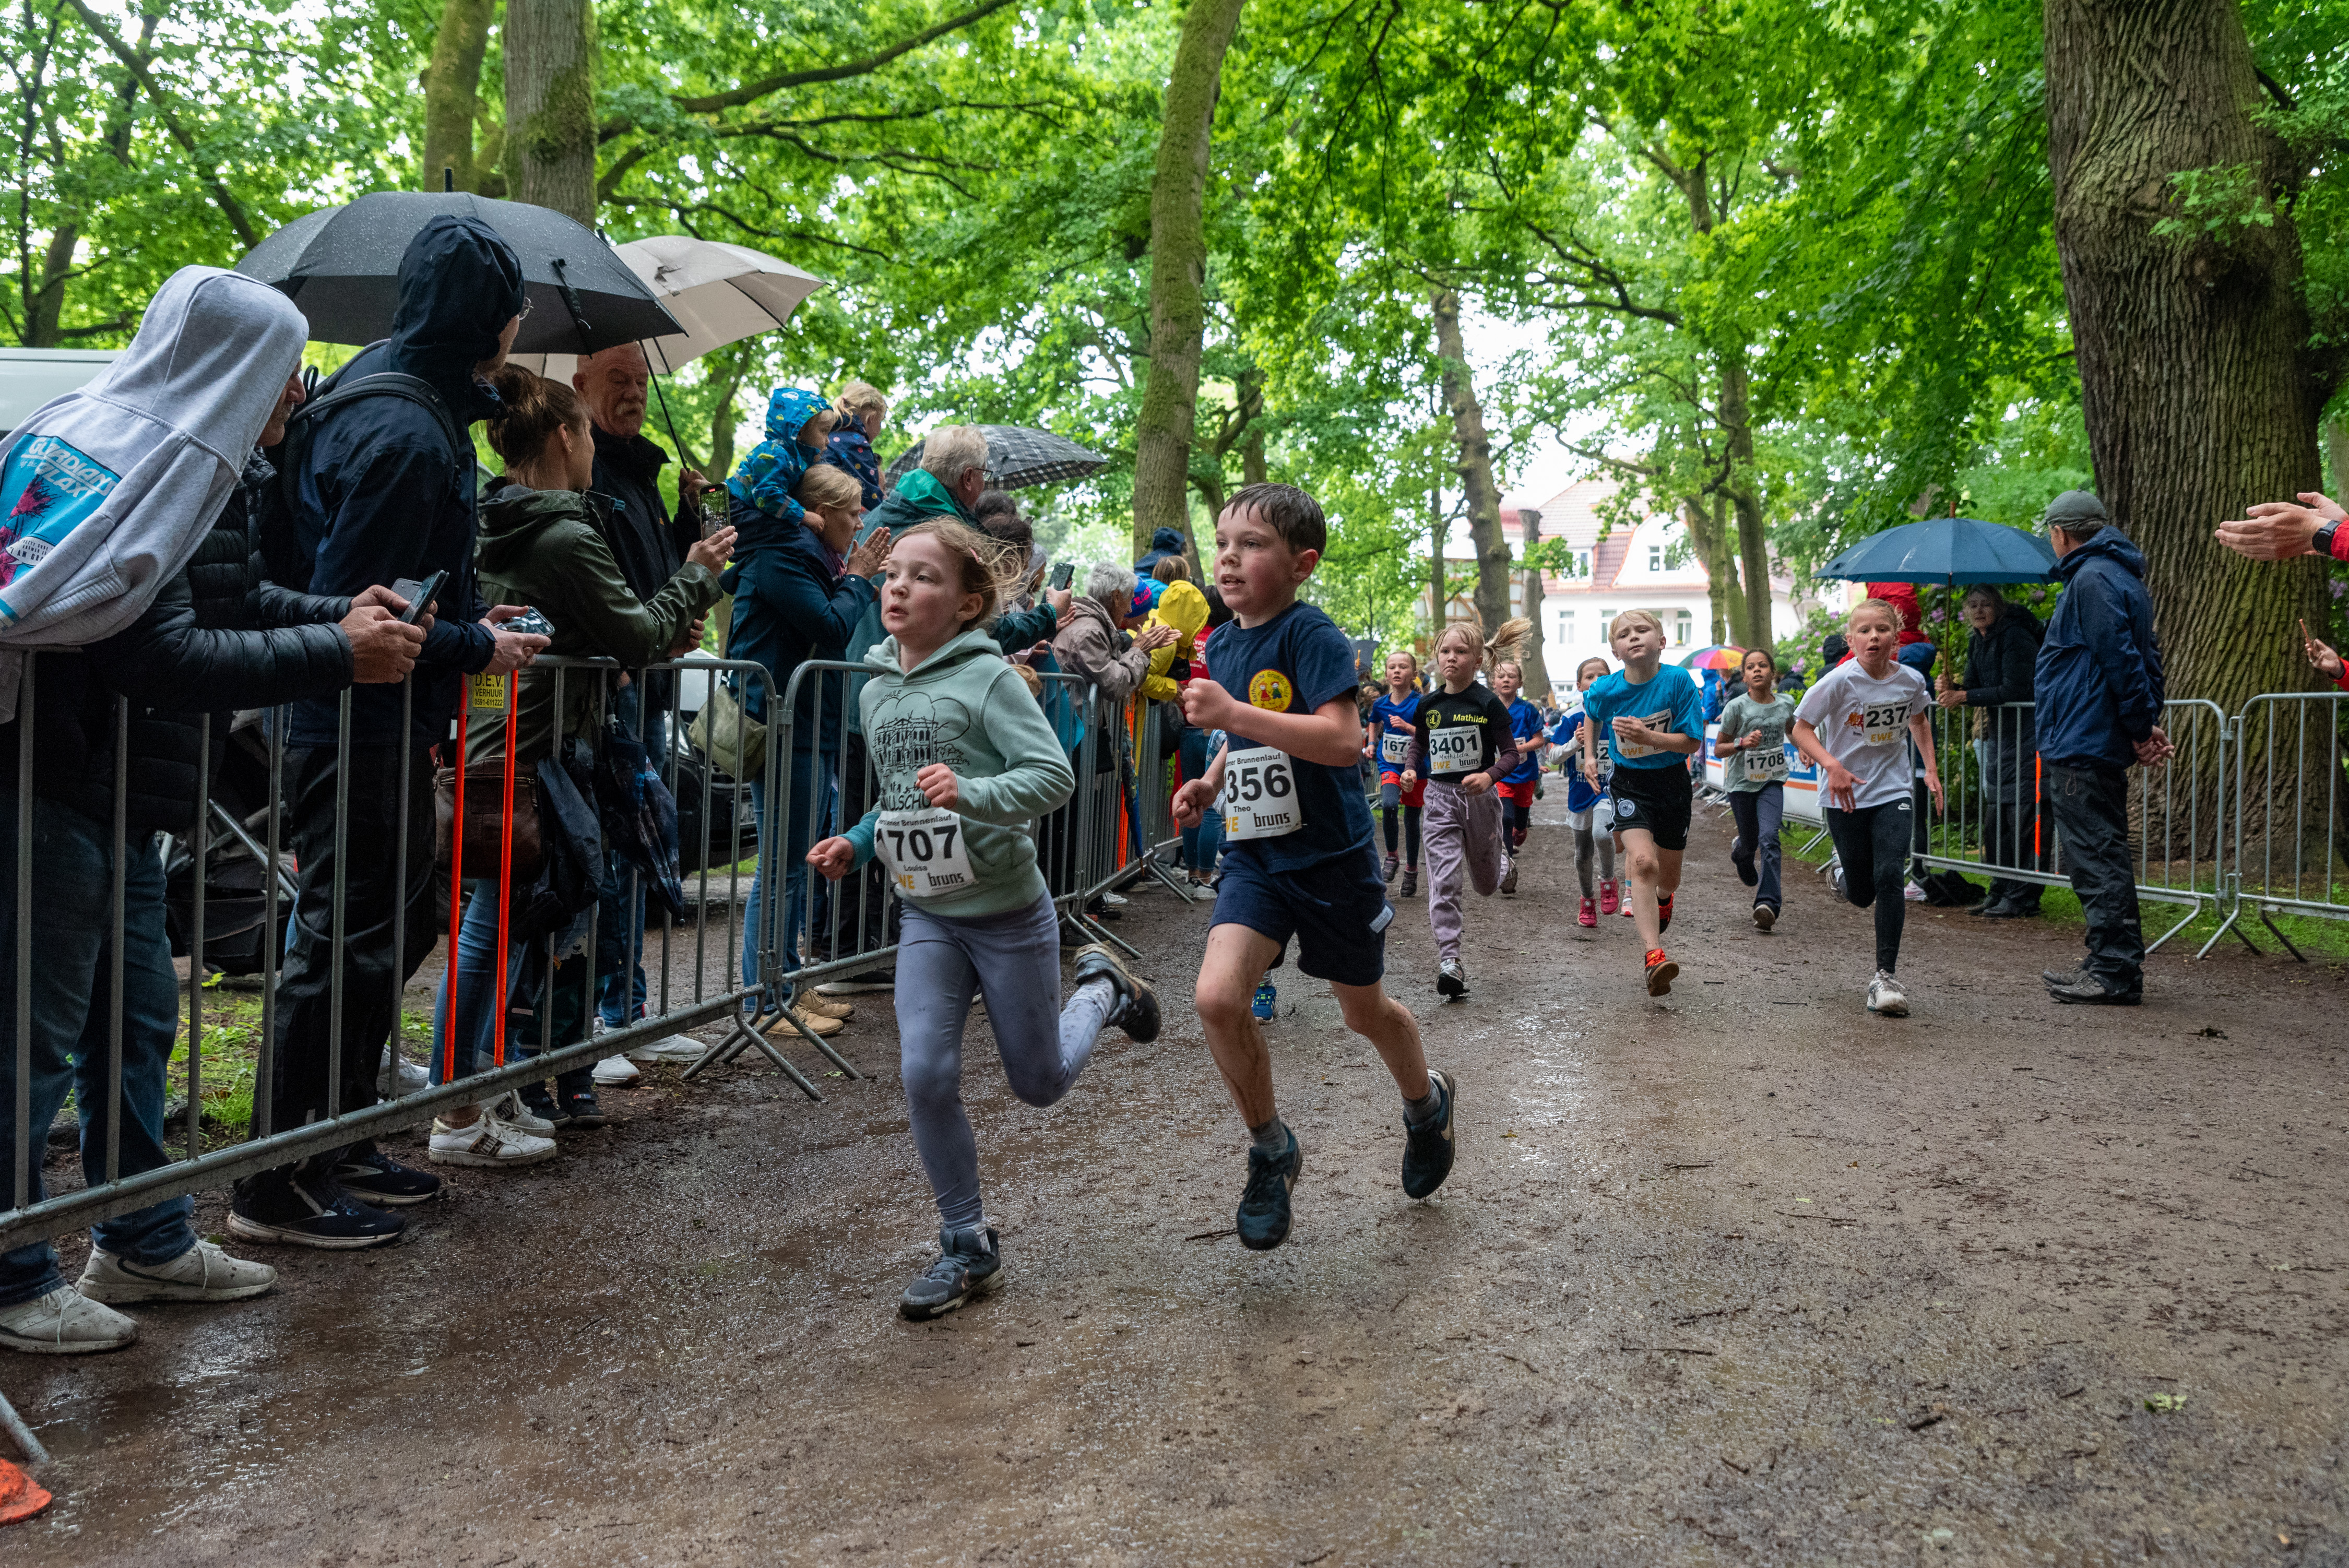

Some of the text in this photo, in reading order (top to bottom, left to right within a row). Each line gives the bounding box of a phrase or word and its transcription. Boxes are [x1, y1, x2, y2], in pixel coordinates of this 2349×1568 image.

[17, 549, 27, 558] AM
[475, 672, 503, 687] D.E.V.
[475, 688, 503, 697] VERHUUR
[1453, 714, 1488, 724] Mathilda
[1641, 712, 1668, 723] runnenlauf
[1870, 732, 1893, 743] EWE
[1383, 739, 1411, 752] 167
[1430, 734, 1478, 755] 3401
[1621, 746, 1644, 755] EWE
[1237, 752, 1282, 765] Brunnenlauf
[1433, 758, 1479, 770] EWE bruns
[1746, 753, 1784, 769] 1708
[1225, 764, 1291, 803] 356
[901, 813, 952, 827] Brunnenlauf
[1253, 812, 1290, 828] bruns
[927, 872, 965, 887] bruns
